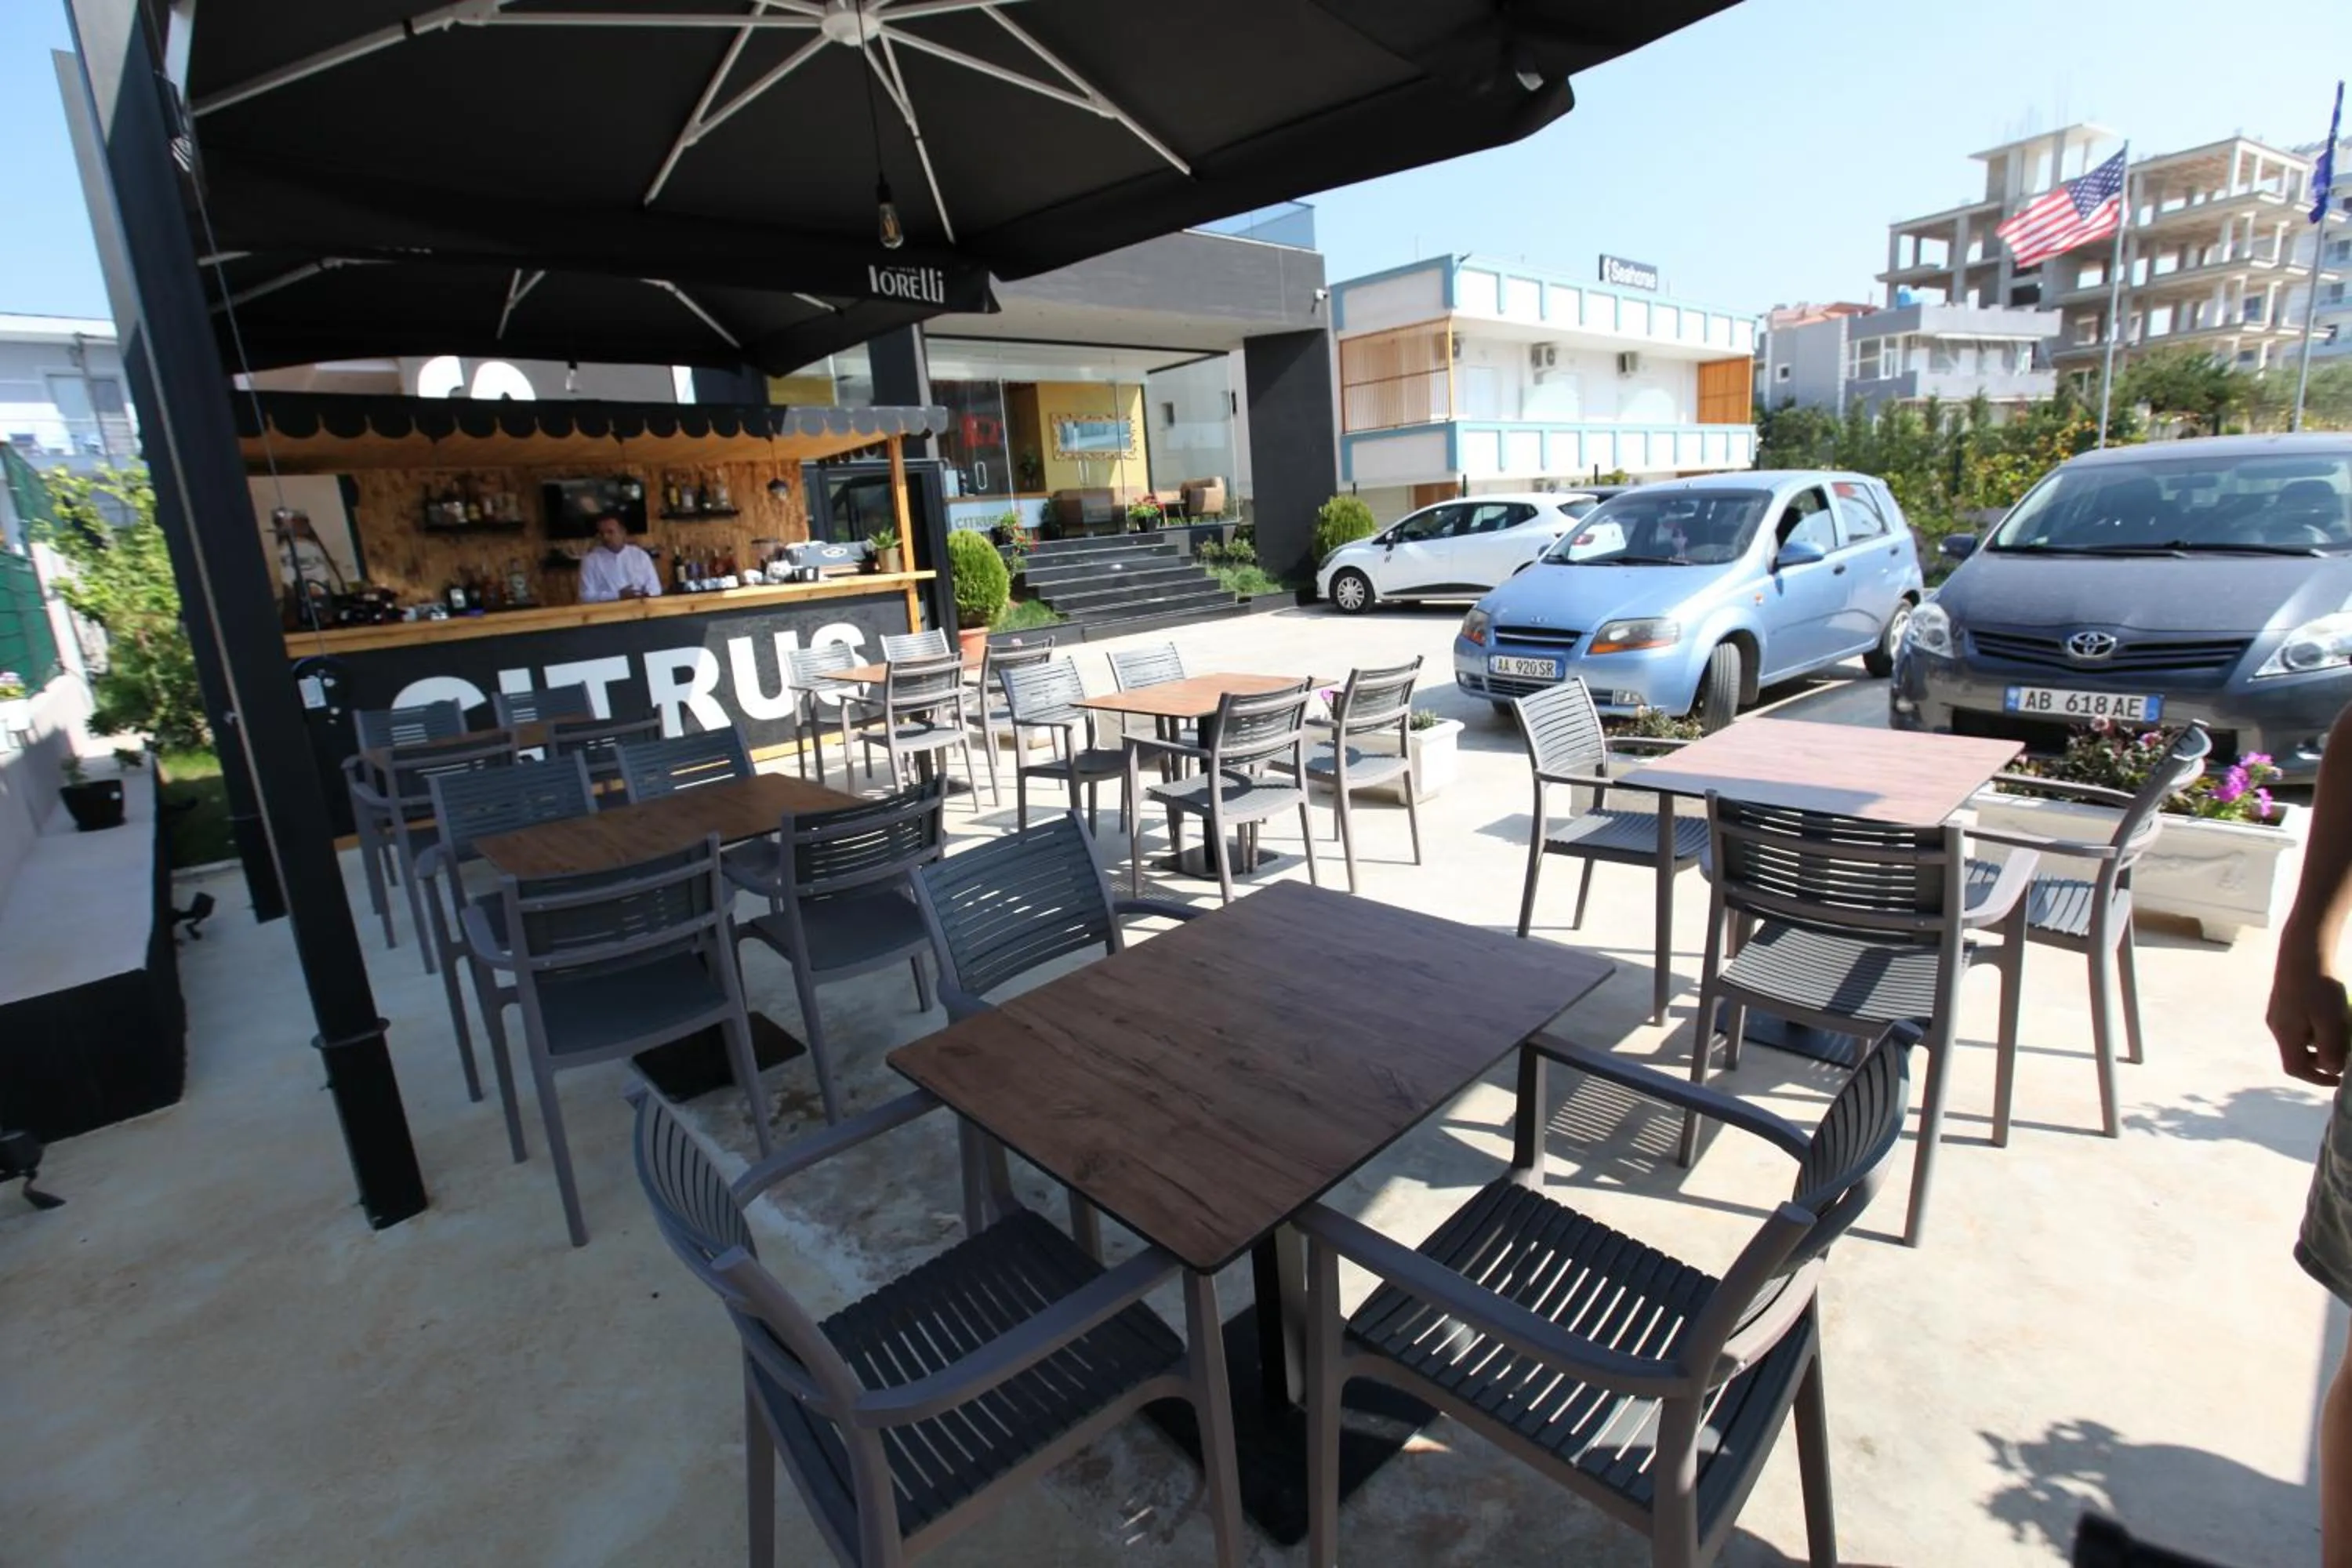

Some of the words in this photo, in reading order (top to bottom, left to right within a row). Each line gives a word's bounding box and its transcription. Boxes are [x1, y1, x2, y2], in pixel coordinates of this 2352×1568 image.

[1497, 657, 1510, 672] AA
[1515, 660, 1537, 676] 920
[1538, 662, 1555, 677] SR
[2024, 690, 2053, 710] AB
[2065, 693, 2109, 715] 618
[2111, 697, 2143, 718] AE
